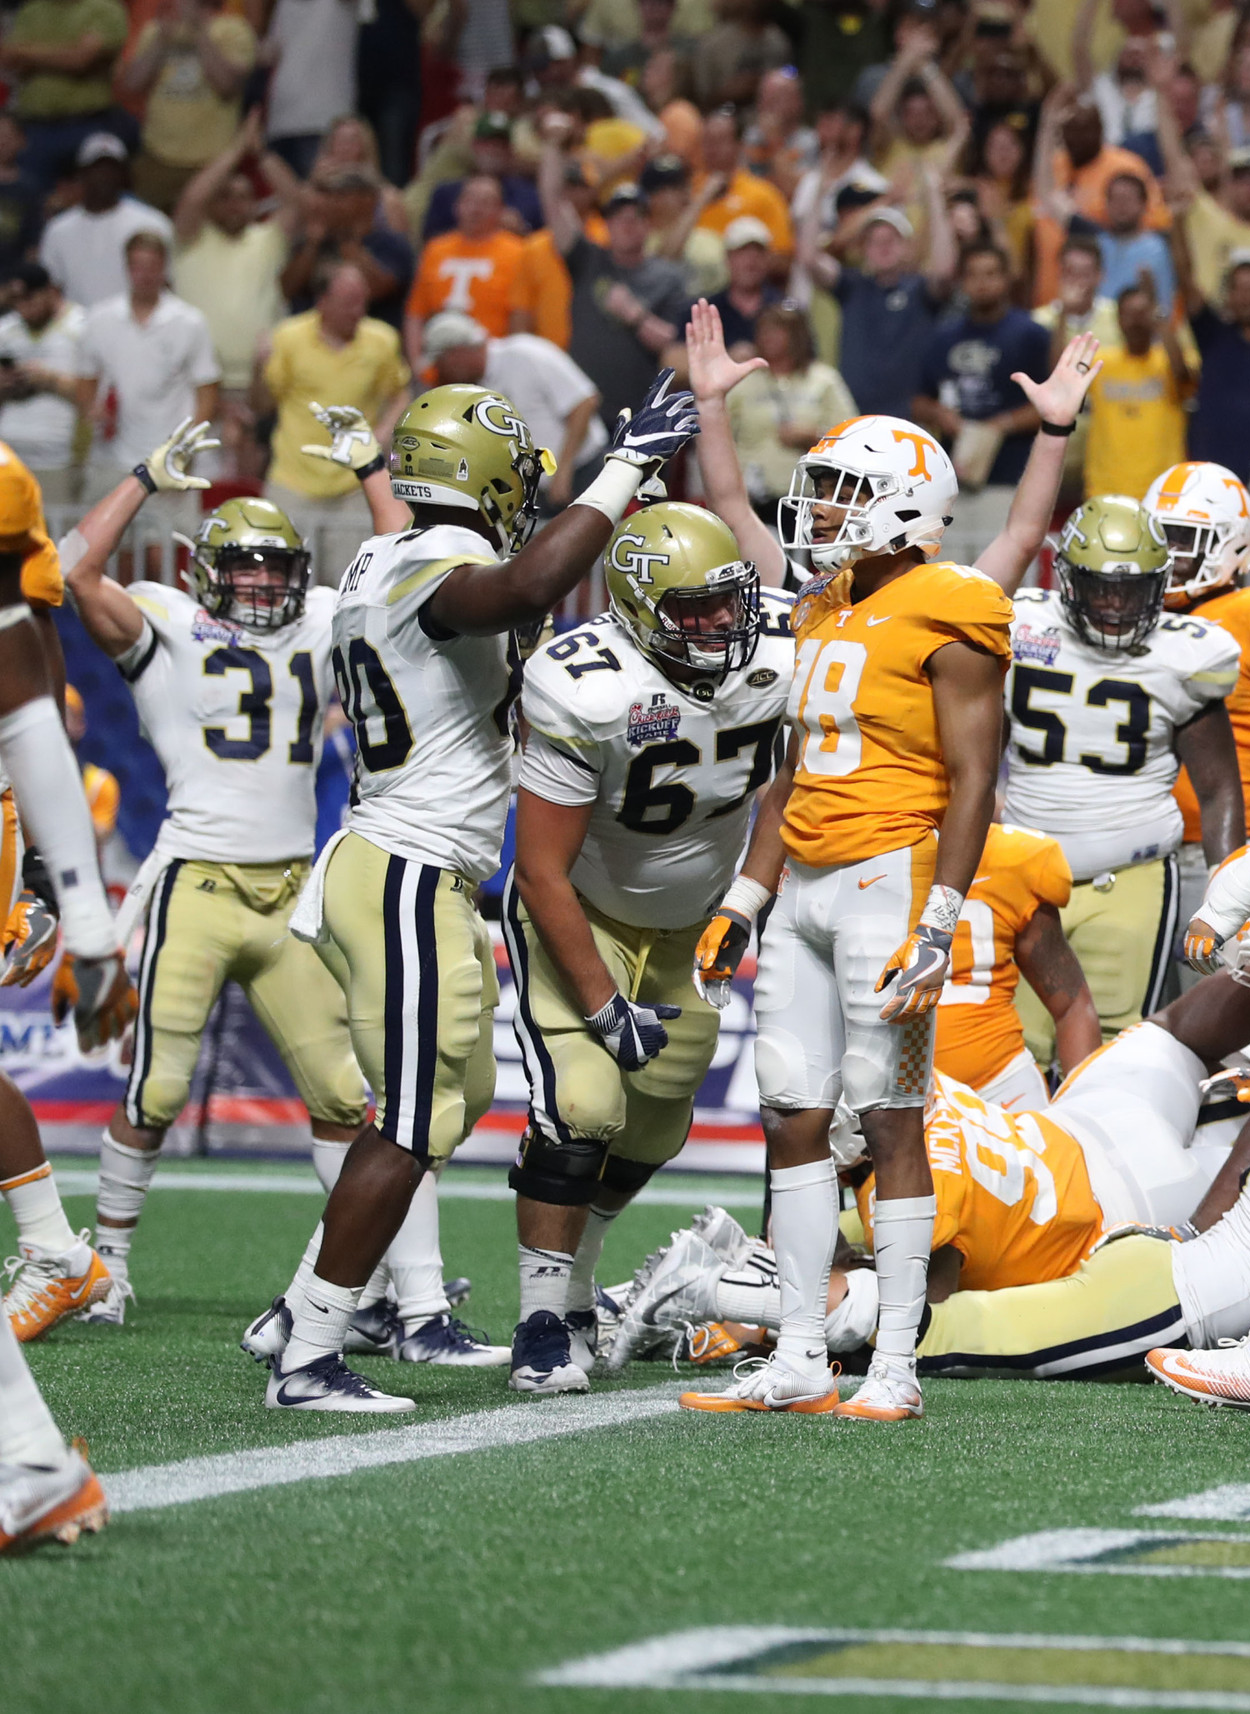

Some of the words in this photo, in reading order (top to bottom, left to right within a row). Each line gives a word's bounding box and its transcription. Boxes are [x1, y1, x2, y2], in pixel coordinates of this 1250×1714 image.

[439, 257, 494, 312] T
[475, 399, 529, 450] GT
[891, 430, 938, 482] T
[394, 484, 432, 498] JACKETS
[1222, 478, 1250, 518] T
[610, 533, 670, 585] GT
[836, 610, 853, 628] T
[546, 631, 624, 683] 67
[752, 671, 774, 684] ACC
[202, 645, 317, 766] 31
[786, 638, 868, 777] 18
[1011, 662, 1151, 776] 53
[615, 714, 784, 835] 67
